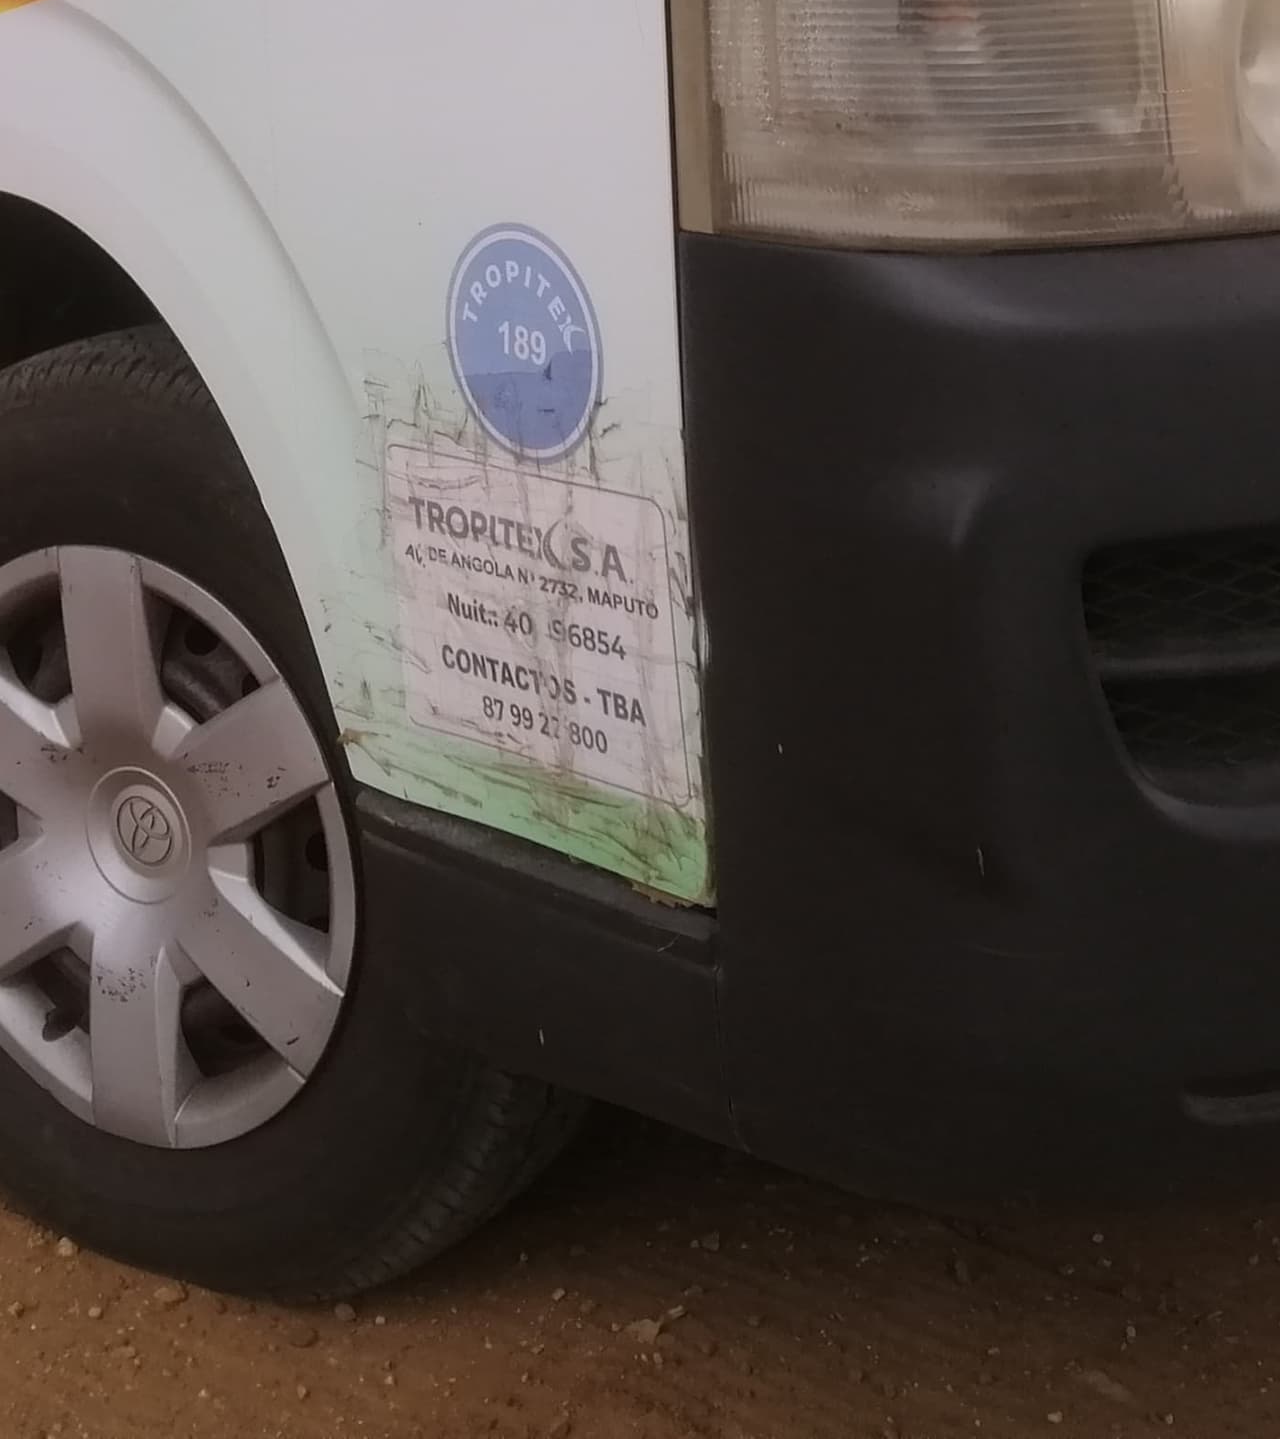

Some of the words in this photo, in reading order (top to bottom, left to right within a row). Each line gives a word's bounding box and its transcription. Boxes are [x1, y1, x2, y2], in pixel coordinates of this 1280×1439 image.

[462, 260, 585, 355] TROPITEX
[498, 321, 547, 366] 189
[408, 495, 568, 571] TROPITEX
[571, 536, 634, 585] S.A.
[428, 546, 448, 565] DE
[450, 552, 515, 580] ANGOLA
[587, 586, 660, 620] MAPUTO
[441, 644, 577, 705] CONTACTOS
[596, 687, 647, 727] TBA
[482, 694, 505, 721] 87
[510, 703, 534, 730] 99
[569, 722, 608, 755] 800
